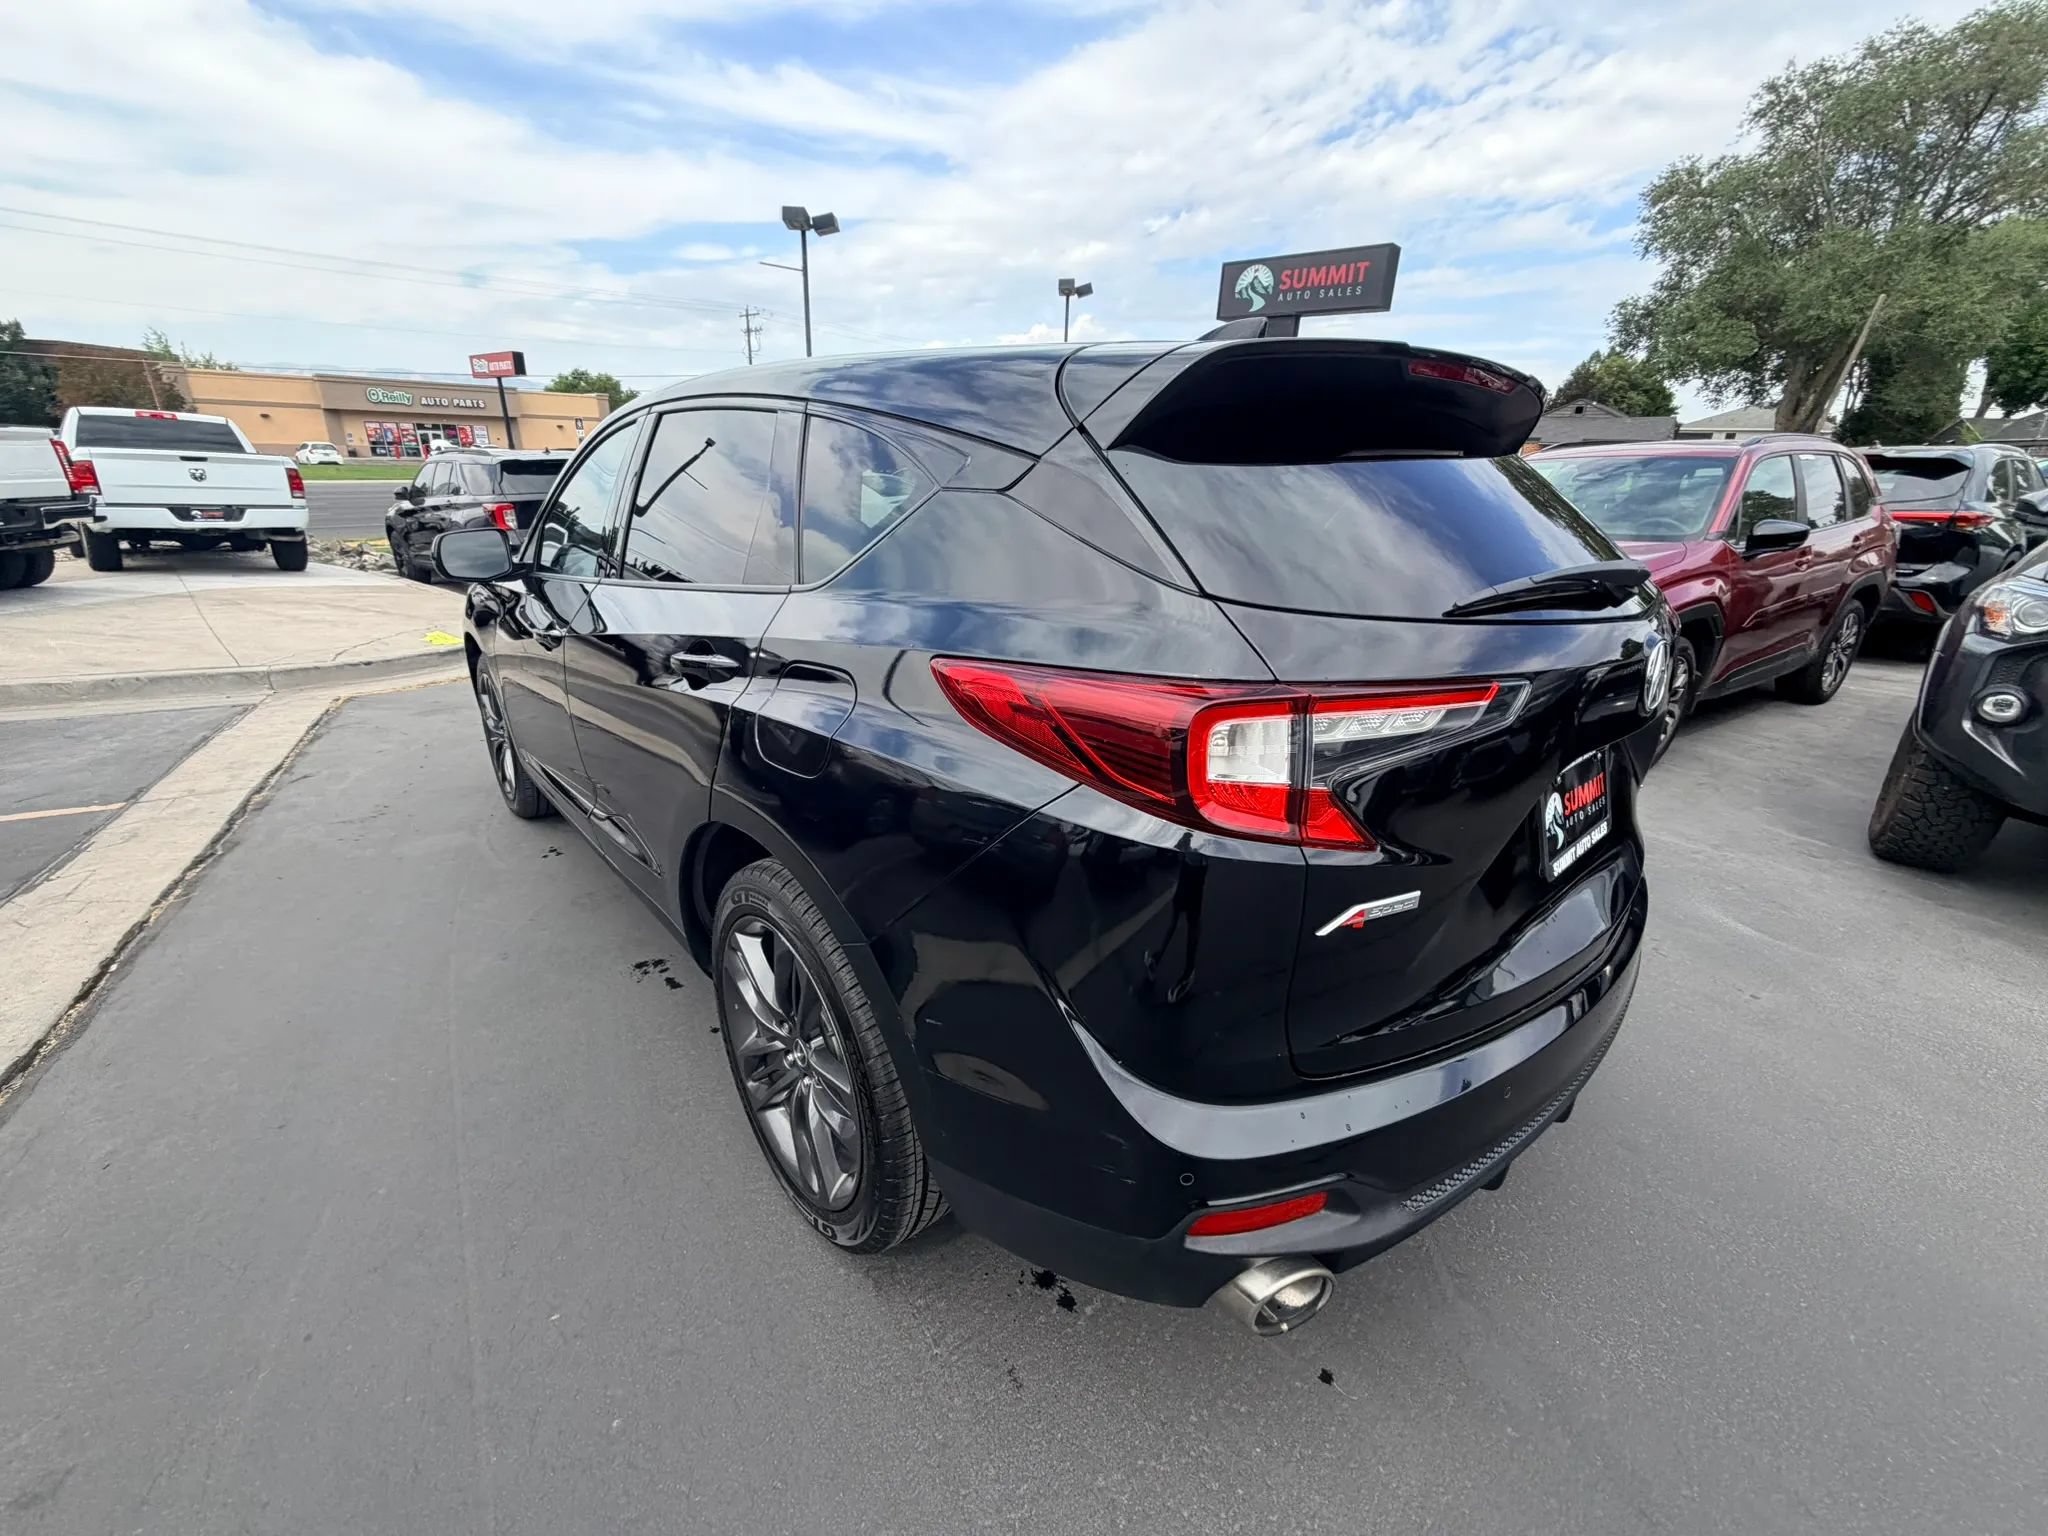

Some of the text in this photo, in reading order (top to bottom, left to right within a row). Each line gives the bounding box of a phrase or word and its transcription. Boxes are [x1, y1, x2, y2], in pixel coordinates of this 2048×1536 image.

[1279, 261, 1371, 290] SUMMIT
[1277, 286, 1363, 302] AUTO SALES
[366, 387, 485, 408] O'Reilly AUTO PARTS
[1564, 772, 1605, 816] SUMMIT
[1565, 796, 1606, 828] AUTO SALES
[1553, 821, 1608, 877] SUMMIT AUTO SALES
